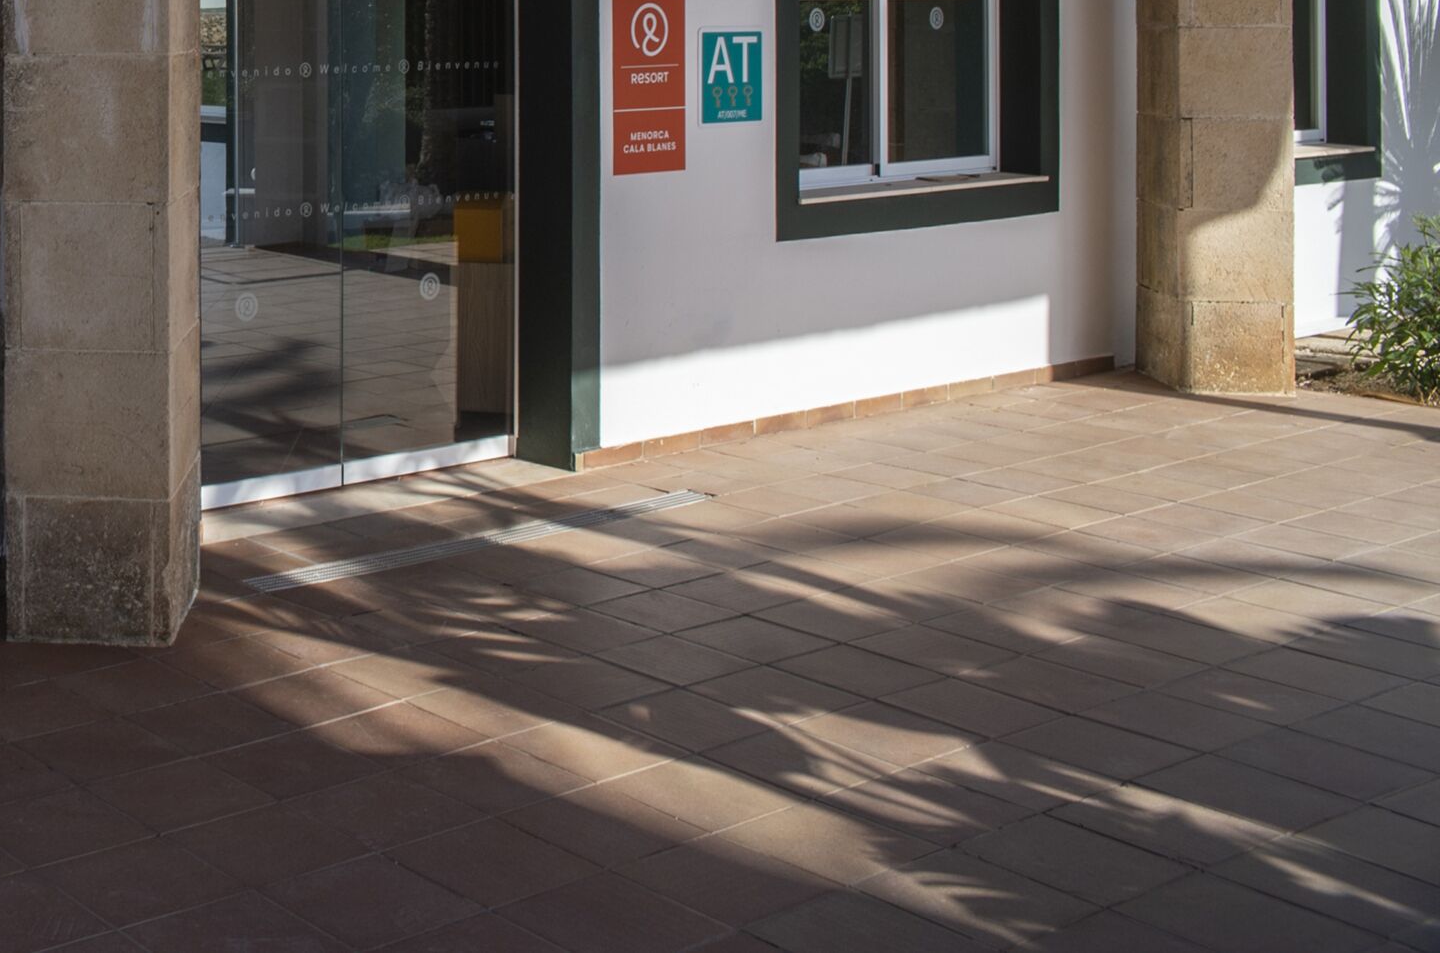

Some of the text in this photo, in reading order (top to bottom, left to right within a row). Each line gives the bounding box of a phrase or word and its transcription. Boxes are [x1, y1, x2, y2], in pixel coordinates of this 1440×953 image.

[707, 35, 758, 84] AT
[320, 63, 391, 75] Welcome
[416, 60, 499, 71] Bienvenue
[630, 130, 669, 140] MENORCA
[623, 141, 676, 154] CALA BLANES
